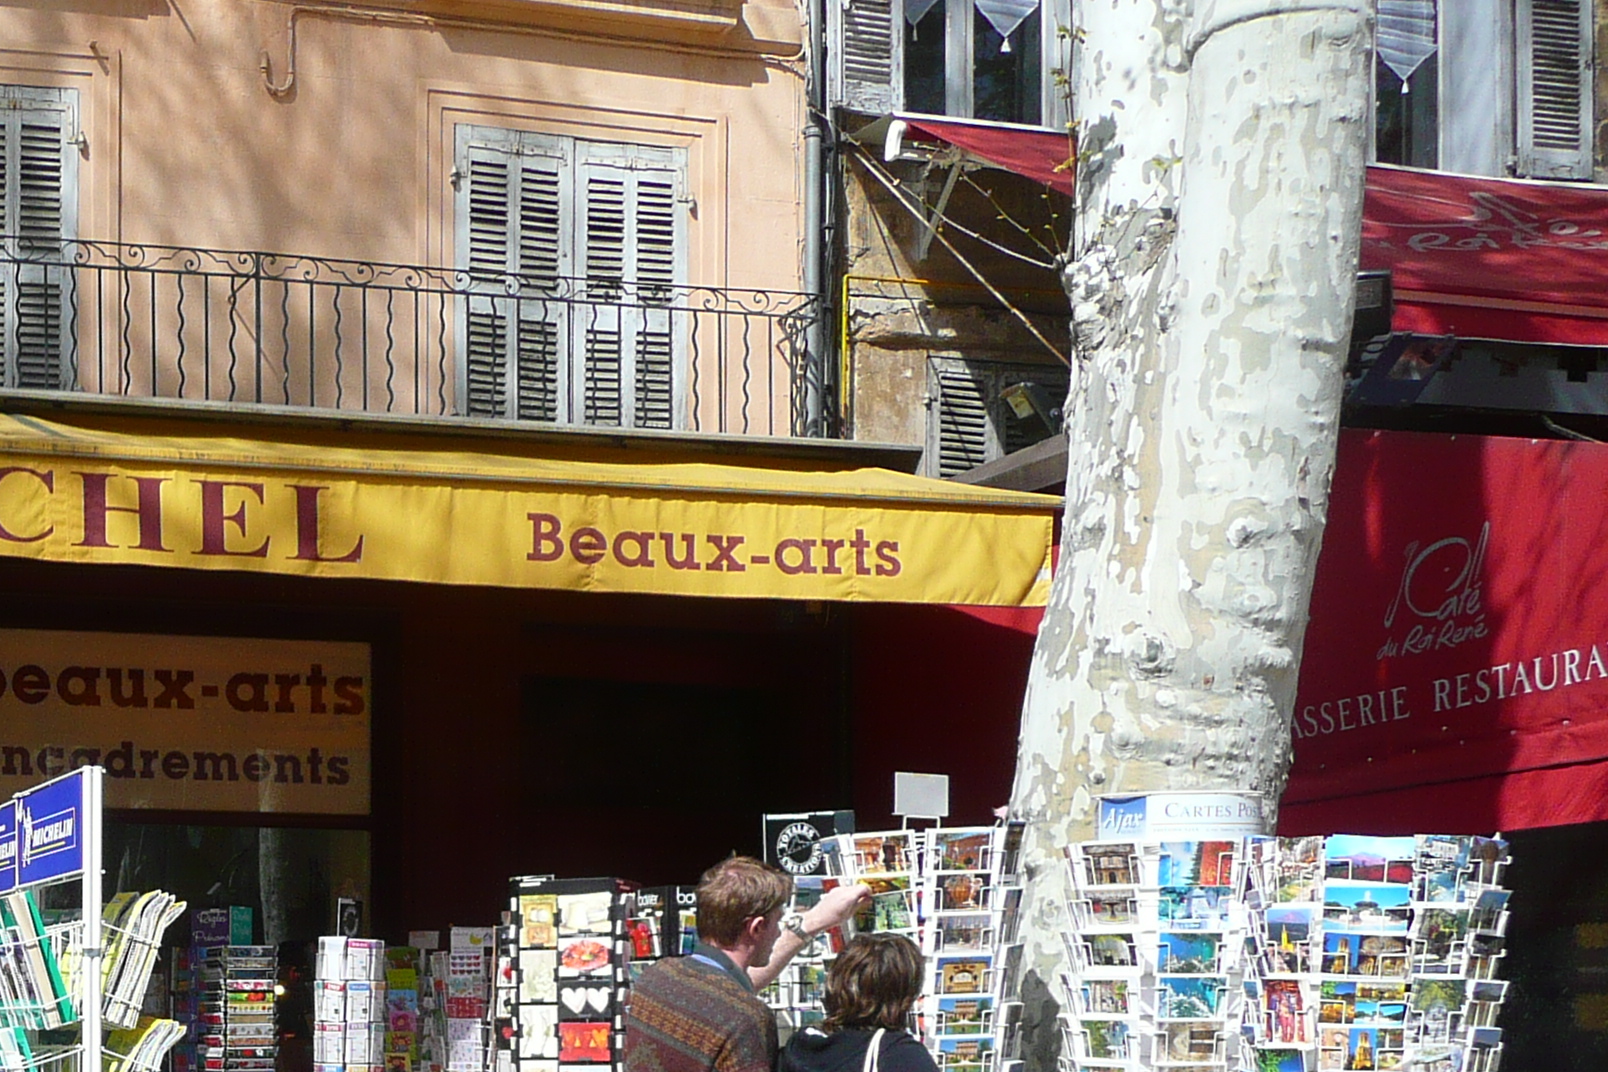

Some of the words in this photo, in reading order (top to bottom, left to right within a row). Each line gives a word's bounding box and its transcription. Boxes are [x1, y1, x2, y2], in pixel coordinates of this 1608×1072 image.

[526, 512, 903, 577] Beaux-arts
[1401, 624, 1434, 656] Roi
[1435, 613, 1489, 651] René
[32, 817, 74, 848] MICHELIN
[1103, 807, 1143, 834] Ajax
[637, 889, 661, 907] bower
